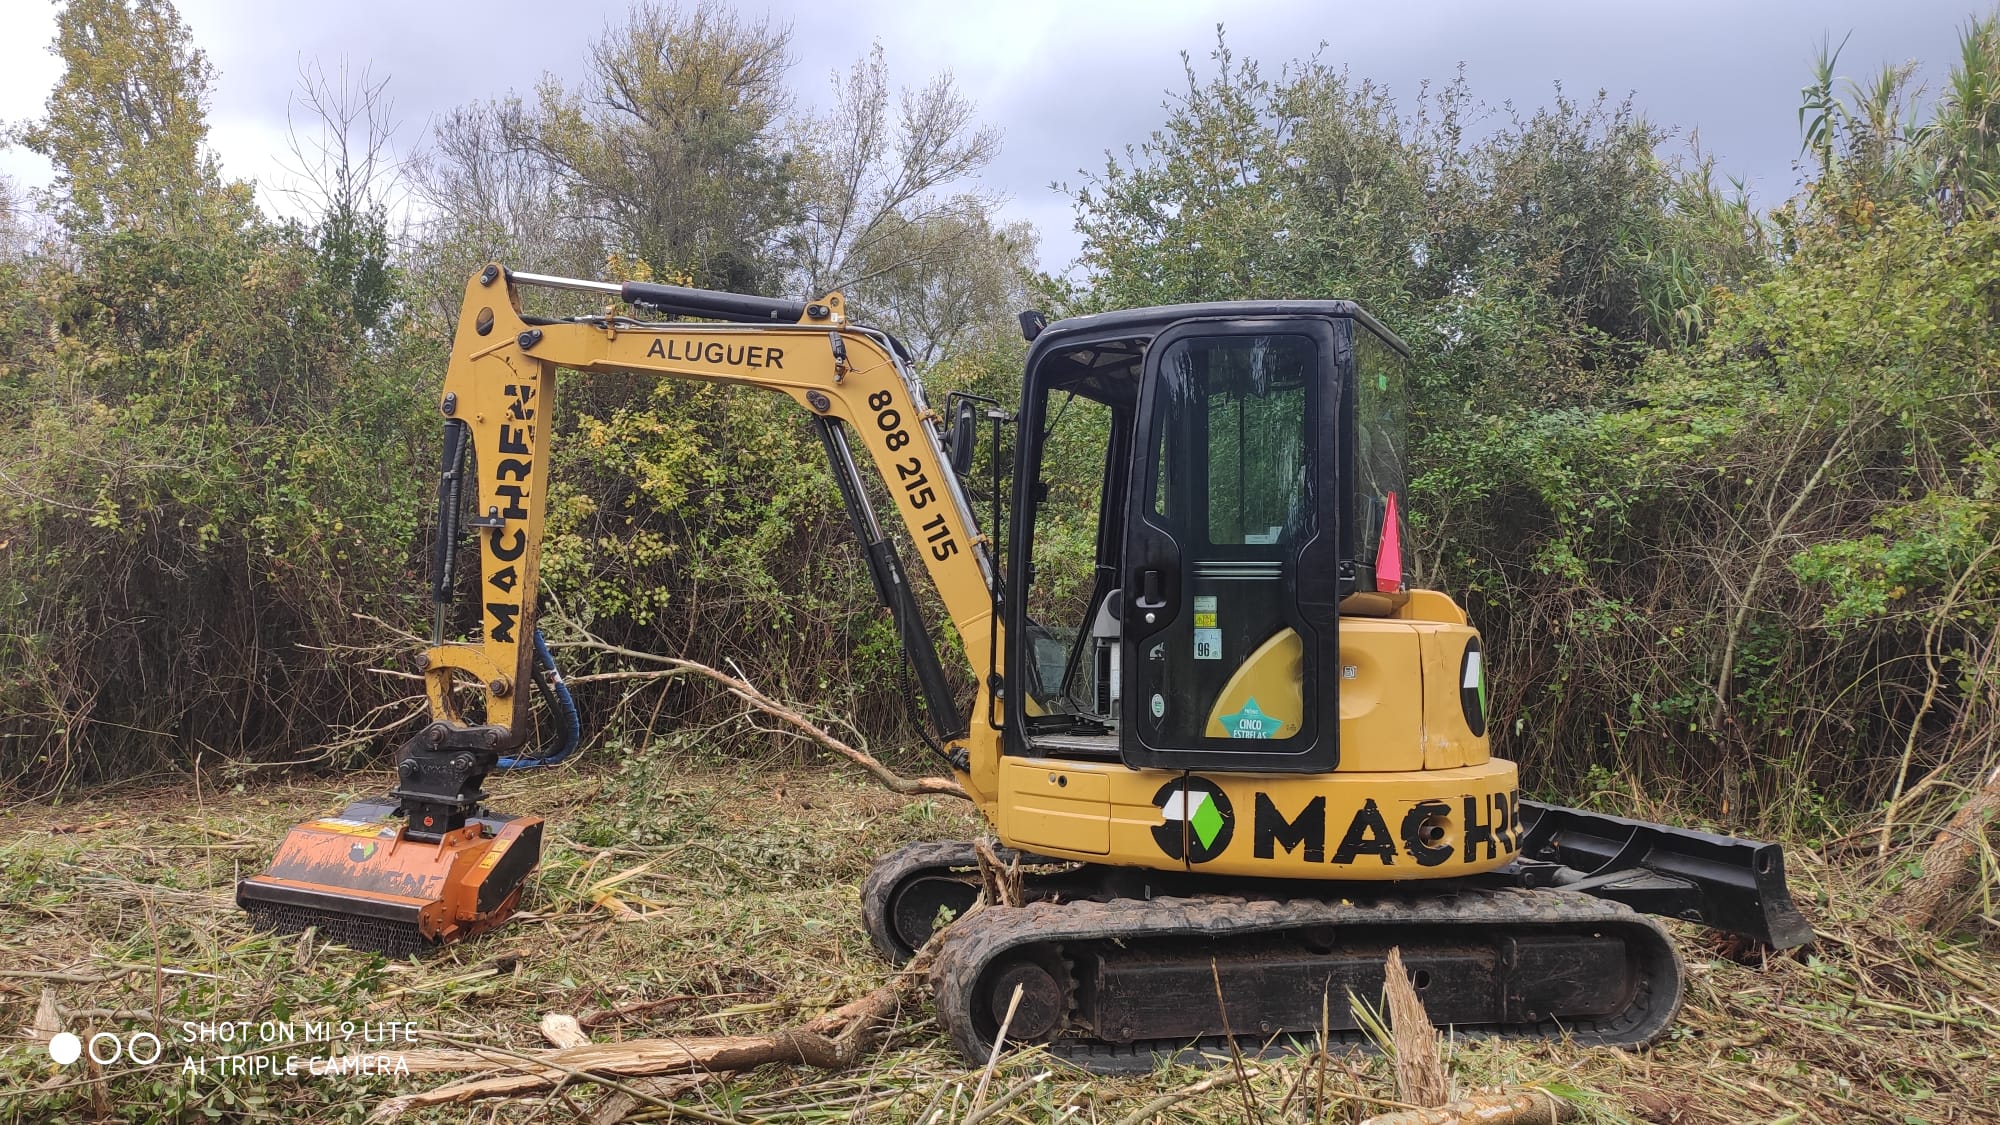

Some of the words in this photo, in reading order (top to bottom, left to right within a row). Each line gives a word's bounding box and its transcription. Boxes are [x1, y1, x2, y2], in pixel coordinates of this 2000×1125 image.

[647, 338, 784, 369] ALUGUER
[868, 390, 910, 452] 808
[895, 457, 937, 510] 215
[922, 513, 959, 562] 115
[486, 357, 537, 643] MACHREN
[1197, 642, 1210, 657] 96
[1233, 730, 1267, 739] ESTRELAS
[1239, 719, 1262, 731] CINCO
